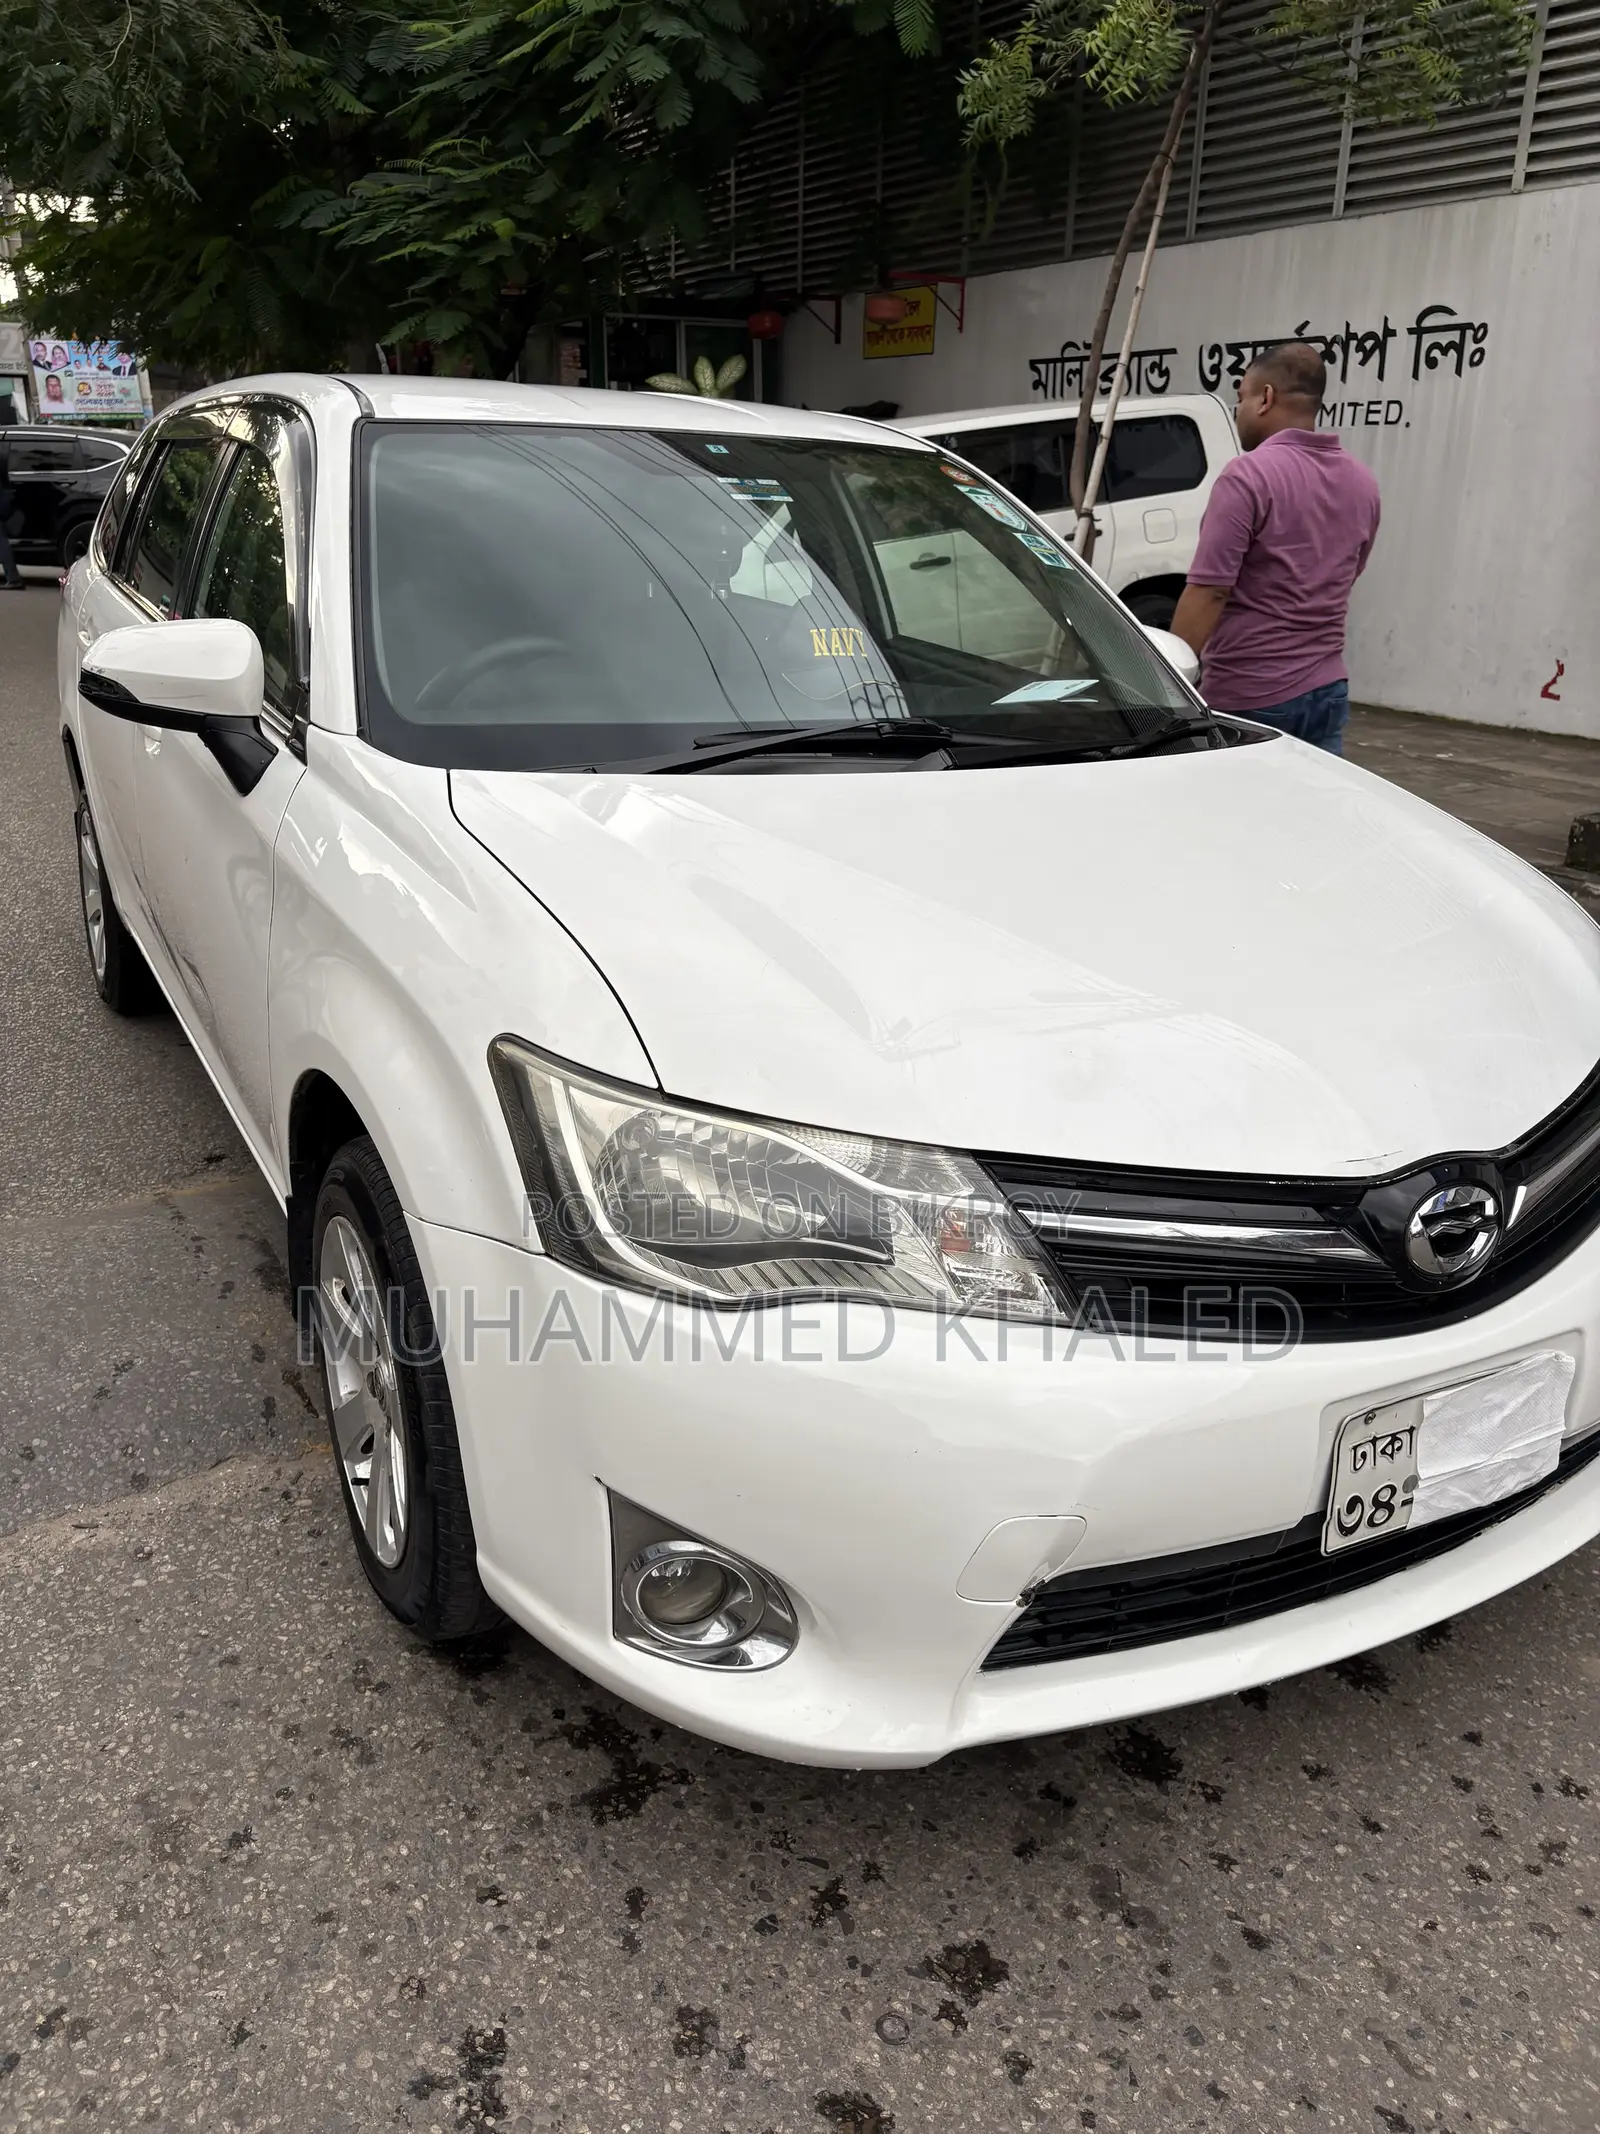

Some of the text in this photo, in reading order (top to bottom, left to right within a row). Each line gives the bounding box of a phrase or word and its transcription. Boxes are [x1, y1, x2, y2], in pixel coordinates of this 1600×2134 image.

[1407, 305, 1488, 381] লিঃ
[1318, 399, 1411, 428] MITED.
[1351, 1424, 1417, 1472] ঢাকা
